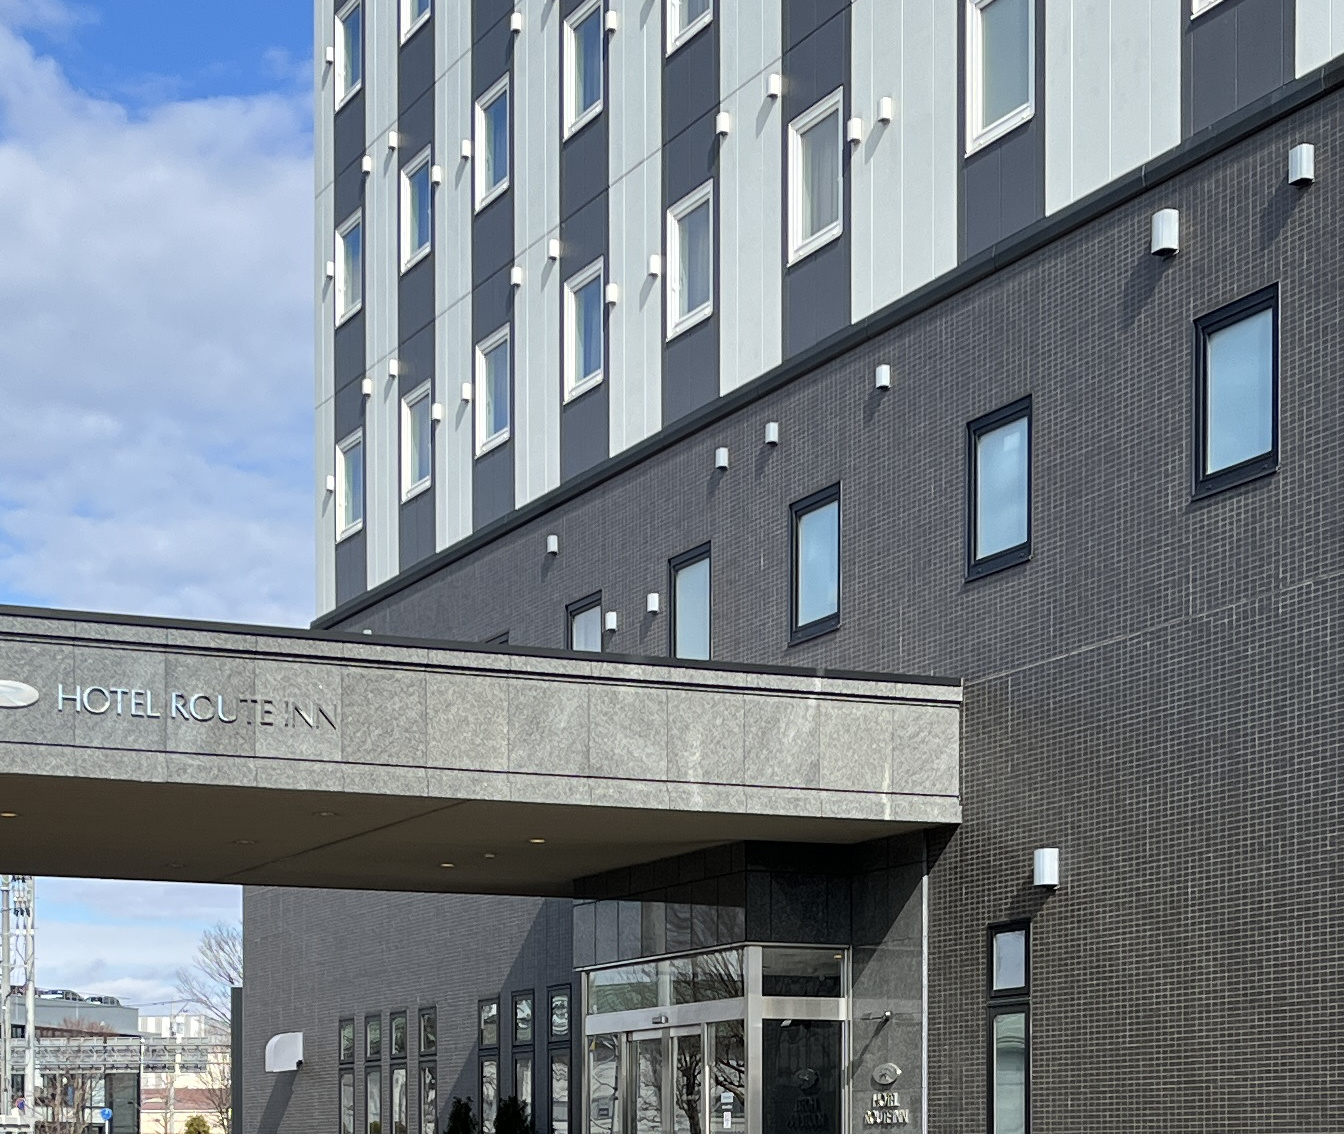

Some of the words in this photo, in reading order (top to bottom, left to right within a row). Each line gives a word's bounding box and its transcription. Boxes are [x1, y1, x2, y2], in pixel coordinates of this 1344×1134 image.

[57, 683, 161, 719] HOTEL
[170, 691, 274, 727] ROUTE
[283, 699, 337, 731] INN
